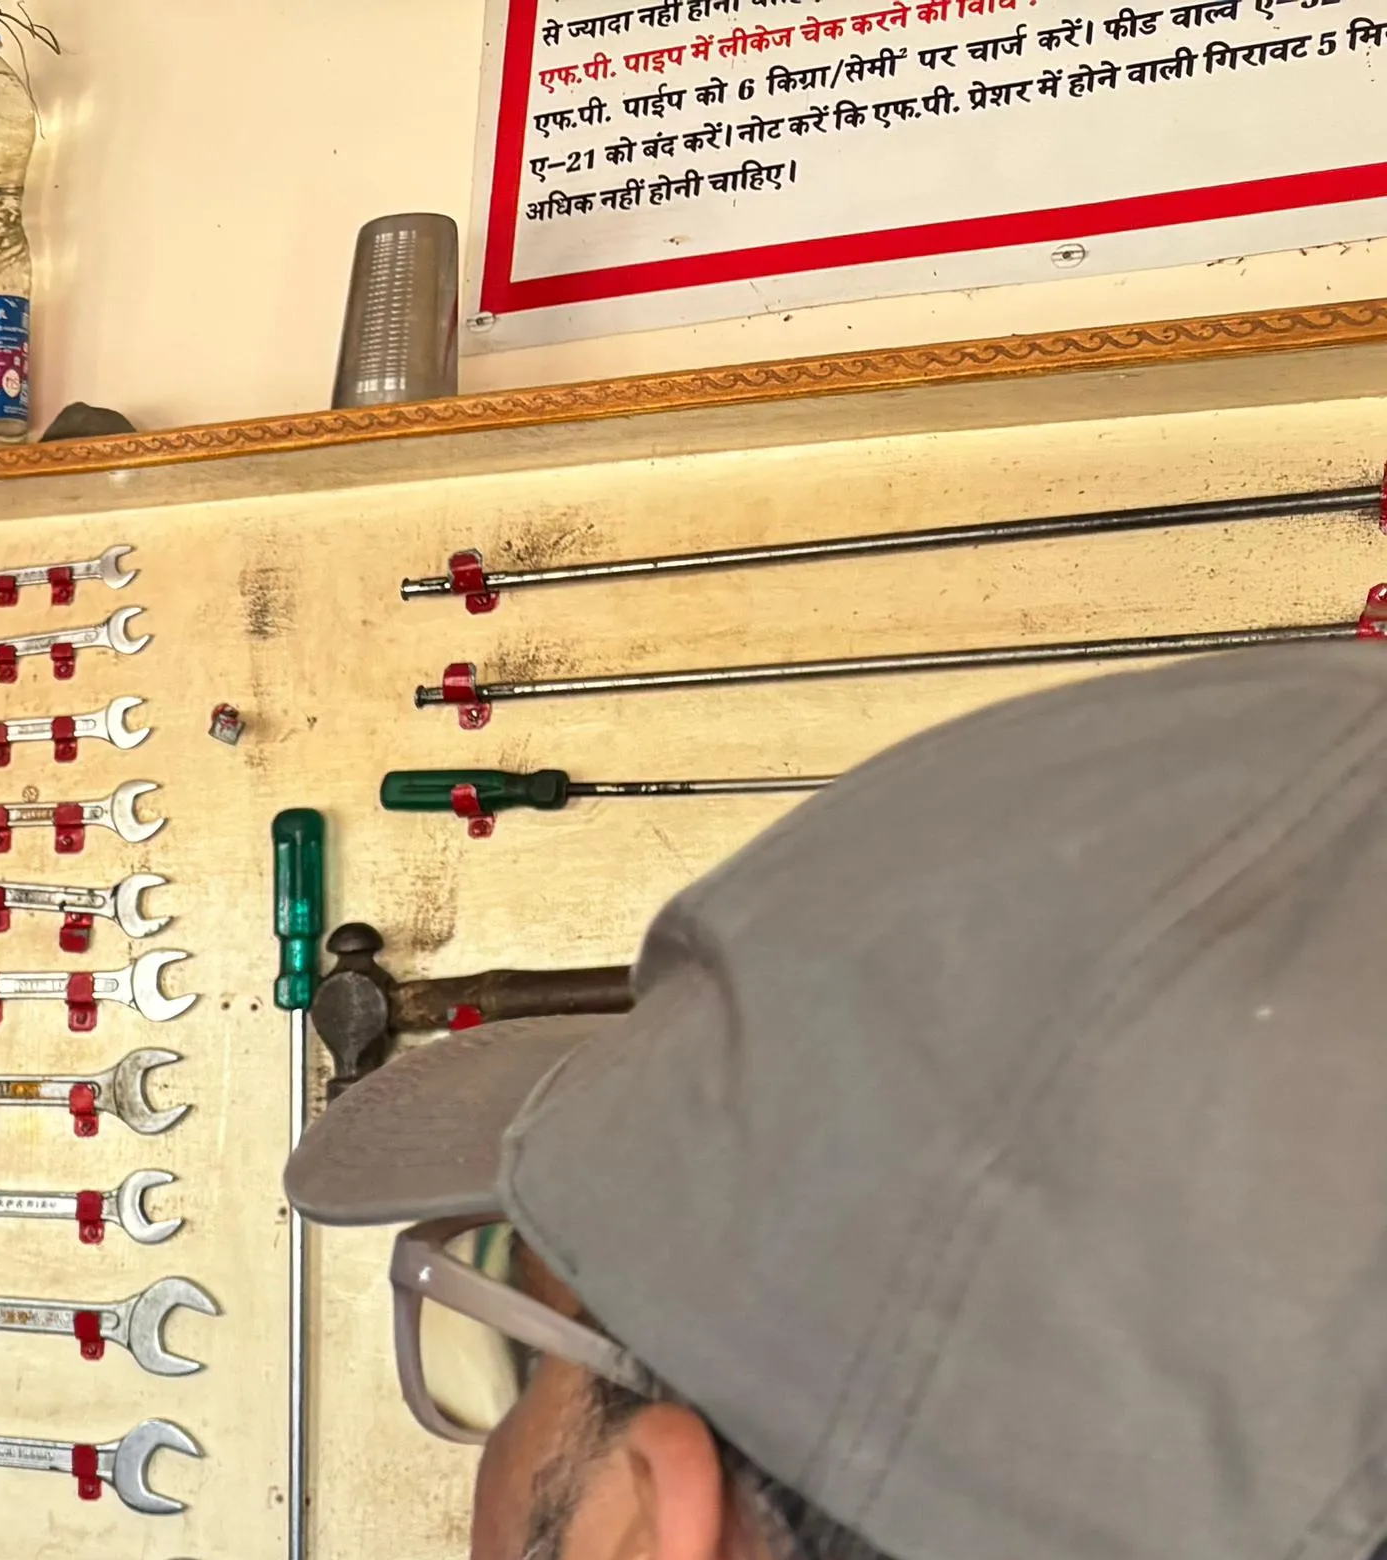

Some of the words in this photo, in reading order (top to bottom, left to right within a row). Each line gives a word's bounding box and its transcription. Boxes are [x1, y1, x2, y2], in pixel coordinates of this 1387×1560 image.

[539, 53, 616, 94] एफ.पी.
[623, 44, 687, 75] पाइप
[691, 33, 714, 63] में
[718, 24, 795, 58] लीकेज
[801, 15, 844, 43] चेक
[851, 4, 911, 37] करने
[544, 20, 562, 46] से
[568, 8, 631, 39] ज्यादा
[534, 100, 611, 139] एफ.पी.
[623, 83, 688, 121] पाईप
[695, 78, 728, 106] को
[738, 78, 755, 100] 6
[918, 45, 957, 71] पर
[966, 24, 1027, 62] चार्ज
[1038, 19, 1094, 52] करें।
[1104, 9, 1163, 41] फीड
[605, 137, 638, 167] को
[642, 129, 676, 159] बंद
[737, 116, 785, 145] नोट
[789, 106, 829, 135] करें
[834, 103, 868, 131] कि
[873, 85, 960, 128] एफ.पी.
[968, 78, 1033, 111] प्रेशर
[1037, 70, 1063, 98] में
[1068, 61, 1122, 98] होने
[1127, 46, 1199, 84] वाली
[1204, 33, 1312, 74] गिरावट
[1317, 31, 1338, 56] 5
[525, 191, 597, 223] अधिक
[601, 180, 645, 212] नहीं
[649, 171, 704, 206] होनी
[708, 160, 797, 194] चाहिए।
